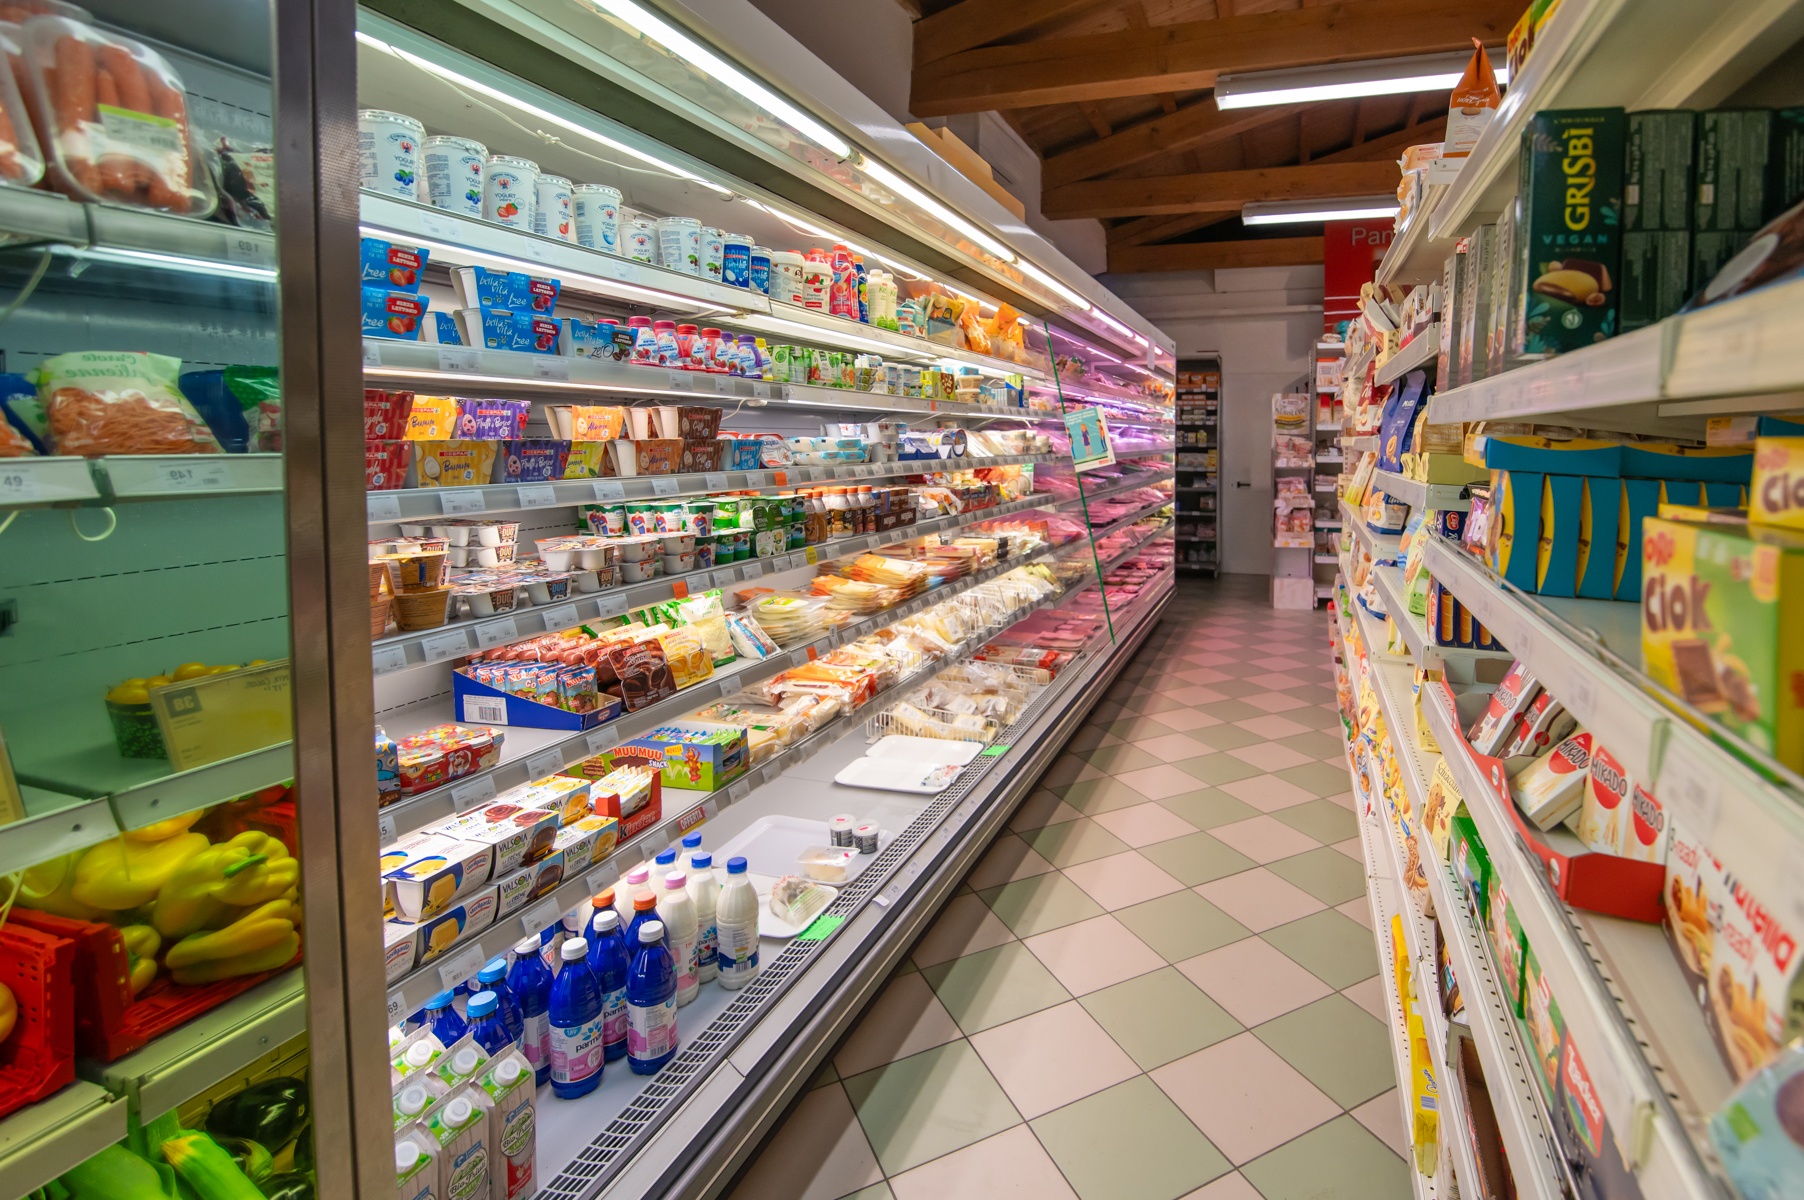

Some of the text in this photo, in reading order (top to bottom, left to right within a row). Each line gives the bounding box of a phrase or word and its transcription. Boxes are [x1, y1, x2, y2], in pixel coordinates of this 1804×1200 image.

[1351, 227, 1394, 246] Pan
[1543, 234, 1608, 245] VEGAN
[411, 416, 435, 428] Banana
[494, 417, 511, 427] Bosco
[442, 460, 470, 473] Banana
[502, 527, 514, 537] DUO
[499, 547, 512, 557] DUO
[496, 594, 512, 605] DUO
[613, 746, 637, 757] MUU
[638, 748, 663, 760] MUU
[1558, 739, 1589, 769] MIKADO
[648, 760, 669, 768] SNACK
[1591, 755, 1627, 797] MIKADO
[1633, 789, 1664, 833] MIKADO
[680, 809, 703, 831] OFFERTA
[498, 832, 528, 852] VALSOIA
[566, 839, 592, 857] VALSOIA
[502, 873, 532, 893] VALSOIA
[503, 1134, 516, 1147] Bio
[451, 1180, 465, 1195] Bio
